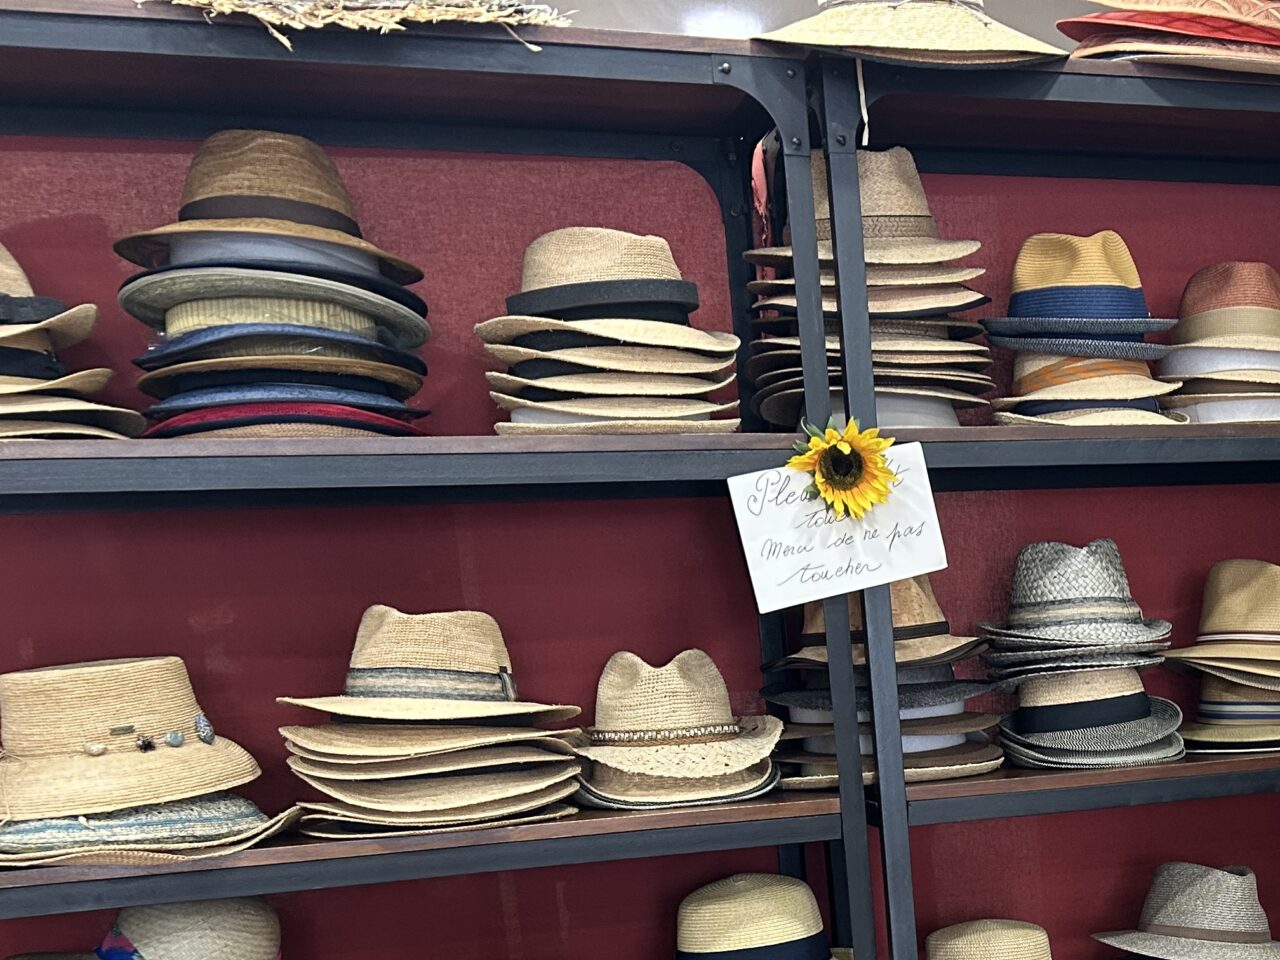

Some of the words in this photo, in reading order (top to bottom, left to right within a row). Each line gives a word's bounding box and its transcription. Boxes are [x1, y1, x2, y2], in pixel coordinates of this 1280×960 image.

[761, 538, 815, 560] Merci
[827, 532, 854, 549] de
[863, 526, 880, 539] ne
[886, 521, 925, 552] pas
[776, 558, 882, 586] toucher
